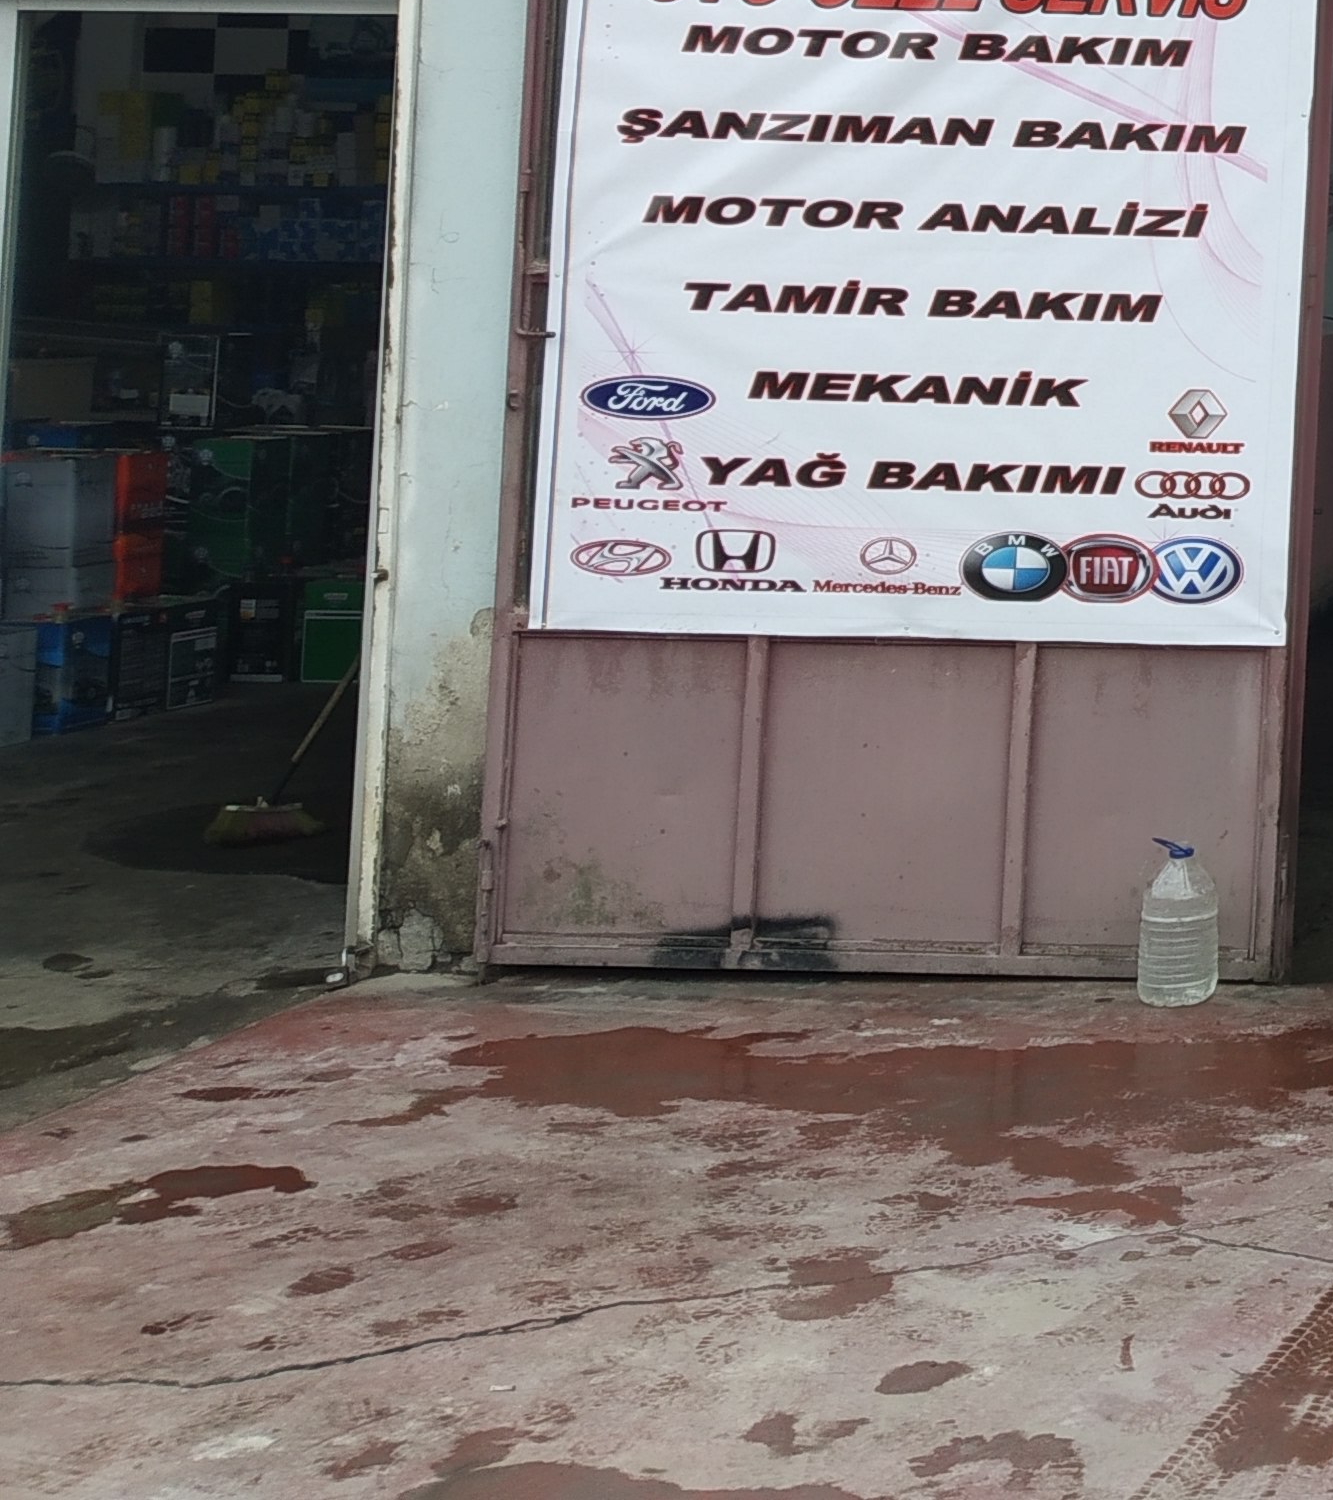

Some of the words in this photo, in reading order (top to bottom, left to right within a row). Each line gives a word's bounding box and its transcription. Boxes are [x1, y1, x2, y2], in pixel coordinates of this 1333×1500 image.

[681, 24, 937, 61] MOTOR
[958, 33, 1193, 68] BAKIM
[616, 108, 993, 149] ŞANZIMAN
[1013, 121, 1248, 155] BAKIM
[643, 195, 904, 232] MOTOR
[916, 202, 1209, 239] ANALİZİ
[683, 279, 910, 317] TAMİR
[928, 289, 1163, 324] BAKIM
[607, 382, 689, 412] Ford
[748, 371, 1089, 408] MEKANİK
[1149, 442, 1245, 454] RENAULT
[701, 453, 847, 488] YAĞ
[866, 461, 1126, 495] BAKIMI
[571, 497, 728, 513] PEUGEOT
[975, 535, 1060, 558] BMW
[659, 577, 807, 592] HONDA
[1080, 556, 1133, 586] FIAT
[812, 579, 961, 597] Mercedes-Benz
